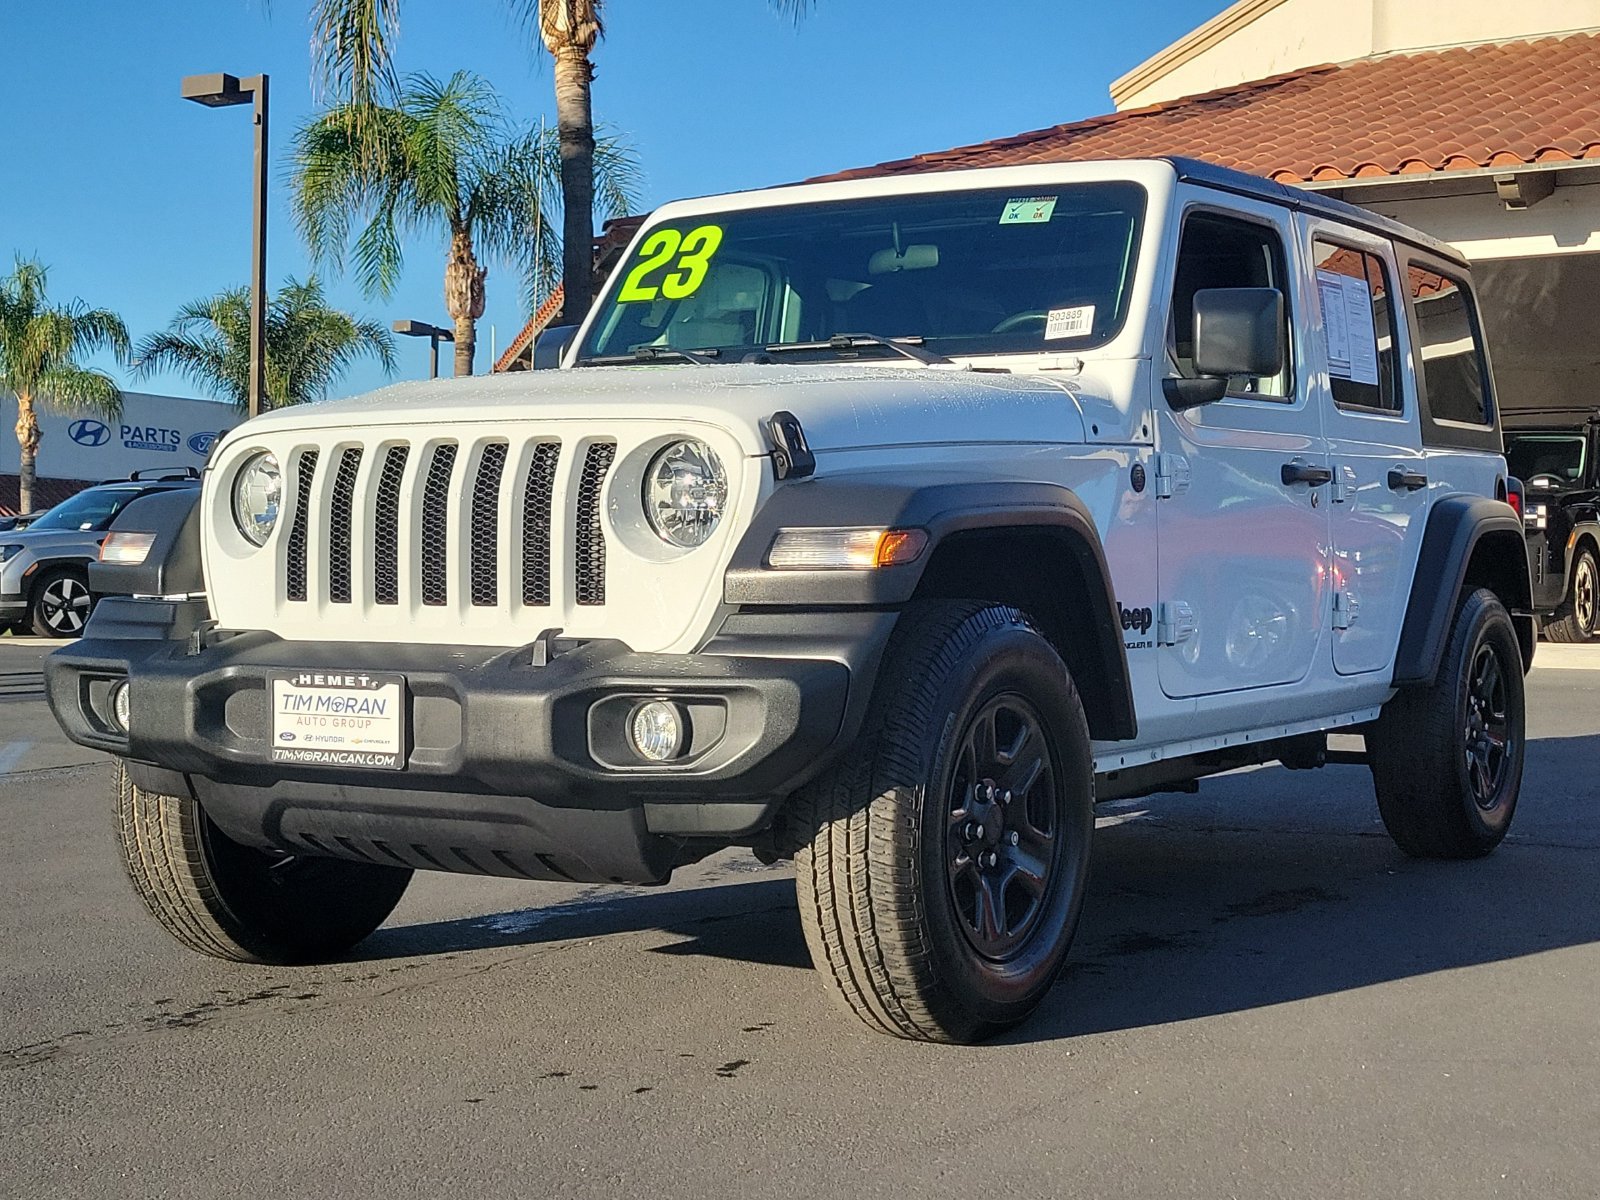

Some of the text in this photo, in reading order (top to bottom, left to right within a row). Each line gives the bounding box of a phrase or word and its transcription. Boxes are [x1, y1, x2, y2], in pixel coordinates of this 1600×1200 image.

[617, 225, 723, 302] 23
[120, 425, 181, 445] PARTS
[300, 674, 370, 687] HEMET
[283, 694, 387, 715] TIM MORAN
[296, 716, 372, 729] AUTO GROUP
[315, 735, 345, 743] HYUNDAI
[274, 749, 396, 766] TIMMORANCAN.COM
